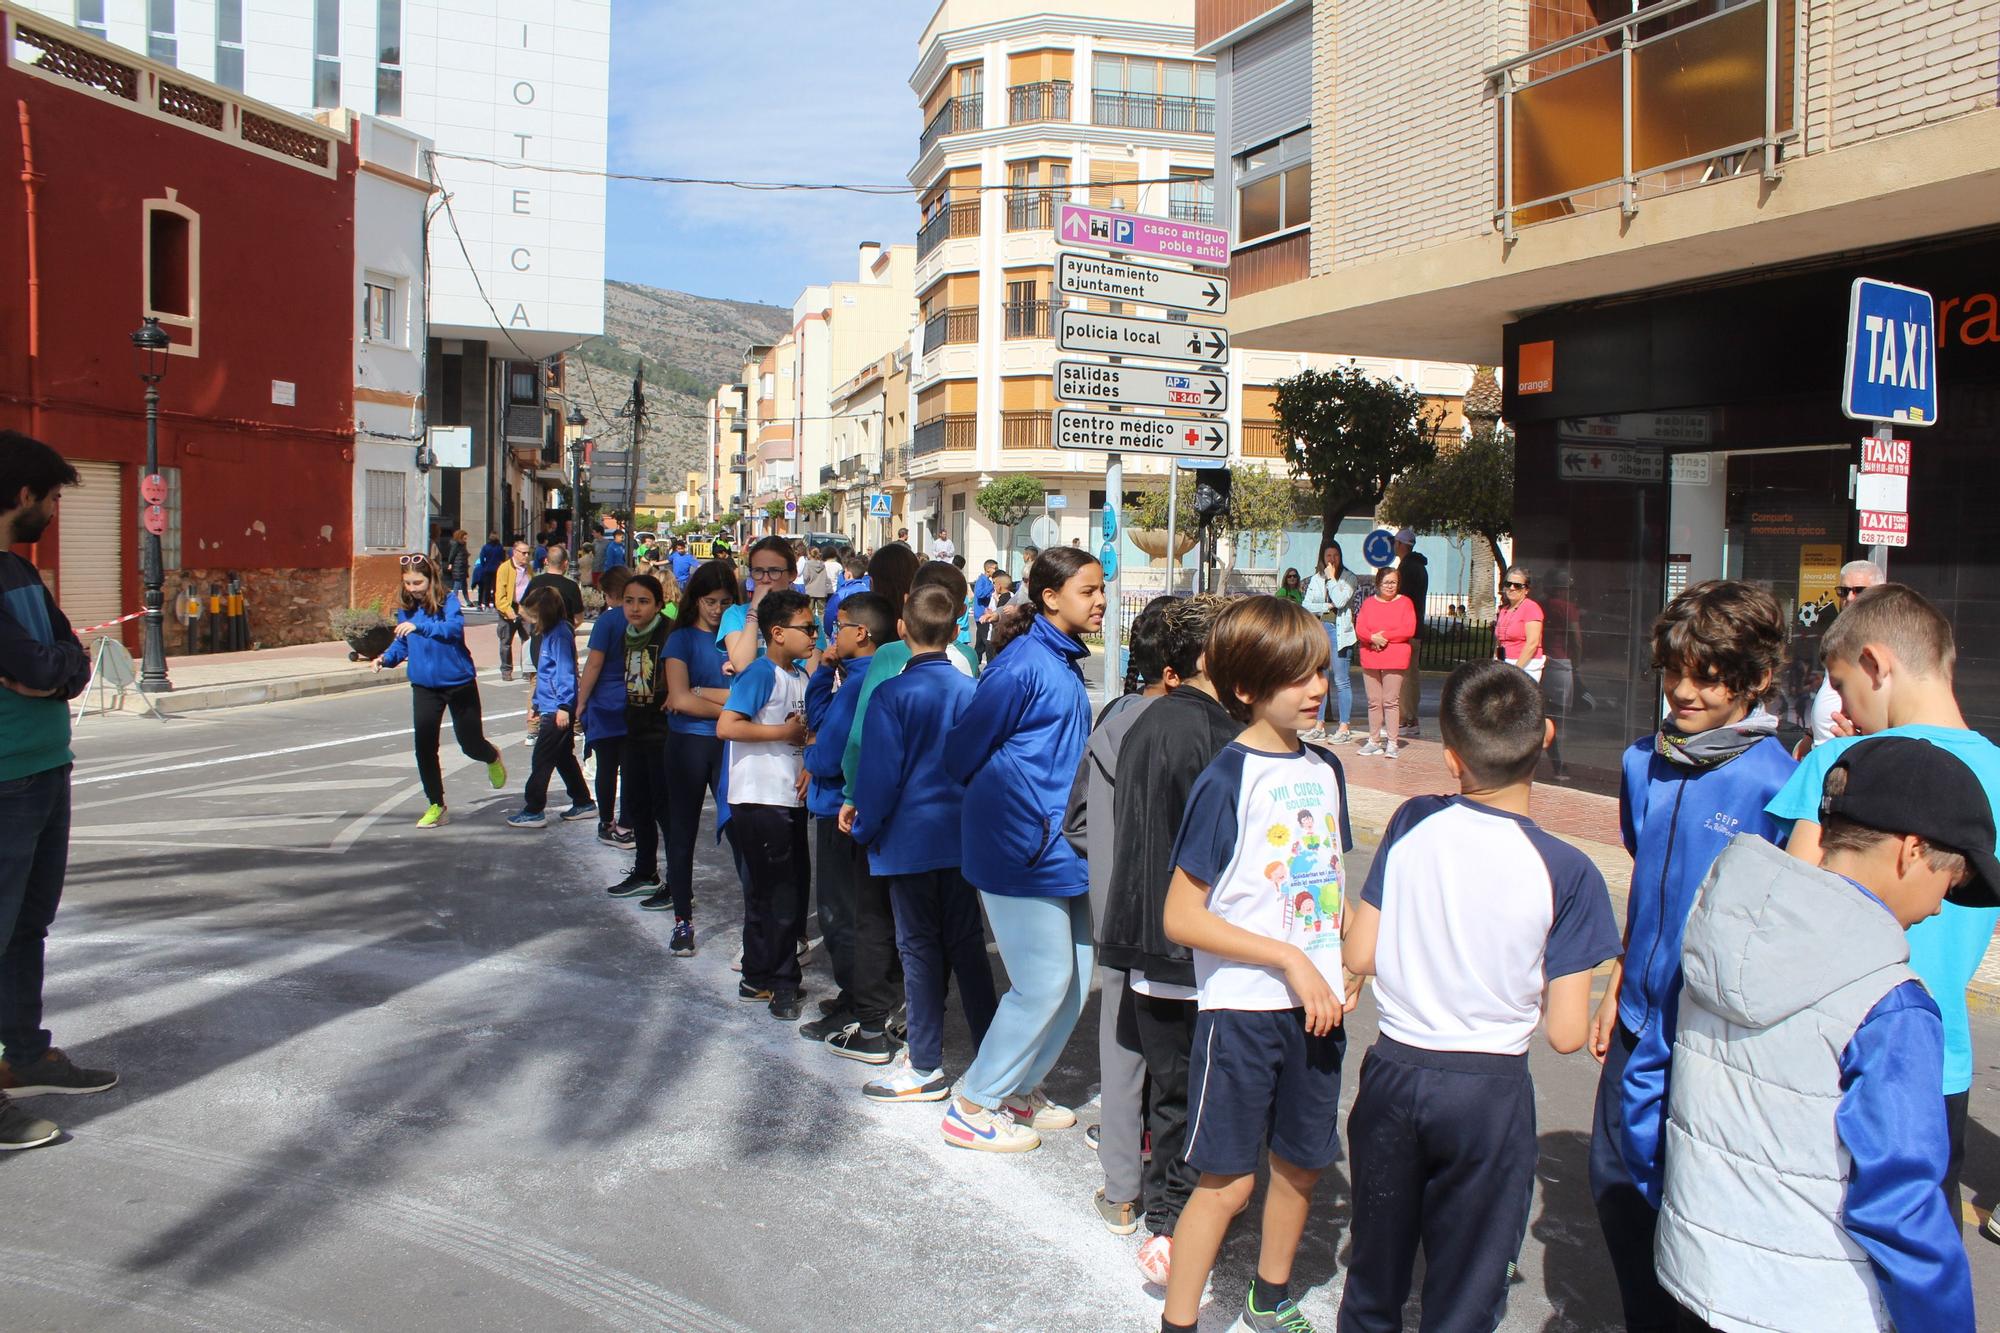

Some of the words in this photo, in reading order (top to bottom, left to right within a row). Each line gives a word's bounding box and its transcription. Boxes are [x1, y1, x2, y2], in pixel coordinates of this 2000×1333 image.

[1144, 224, 1178, 237] casco
[1182, 229, 1225, 244] antiguo
[1160, 240, 1192, 253] poble
[1196, 246, 1225, 257] antic
[1067, 261, 1159, 282] ayuntamiento
[1067, 276, 1145, 297] ajuntament
[1066, 323, 1118, 340] policia
[1124, 327, 1161, 344] local
[1865, 314, 1927, 390] TAXI
[1064, 366, 1120, 382] salidas
[1063, 381, 1120, 397] eixides
[1166, 377, 1190, 388] AP-7
[1519, 379, 1549, 392] orange
[1169, 391, 1201, 404] N-340
[1063, 416, 1114, 430] centro
[1120, 419, 1174, 434] médico
[1063, 431, 1114, 445] centre
[1865, 439, 1906, 465] TAXIS
[1861, 513, 1892, 530] TAXI
[1862, 533, 1875, 543] 628
[1876, 534, 1885, 543] 72
[1887, 535, 1895, 543] 17
[1896, 536, 1905, 544] 68
[1293, 782, 1325, 797] CURSA
[1715, 812, 1738, 827] CEIP
